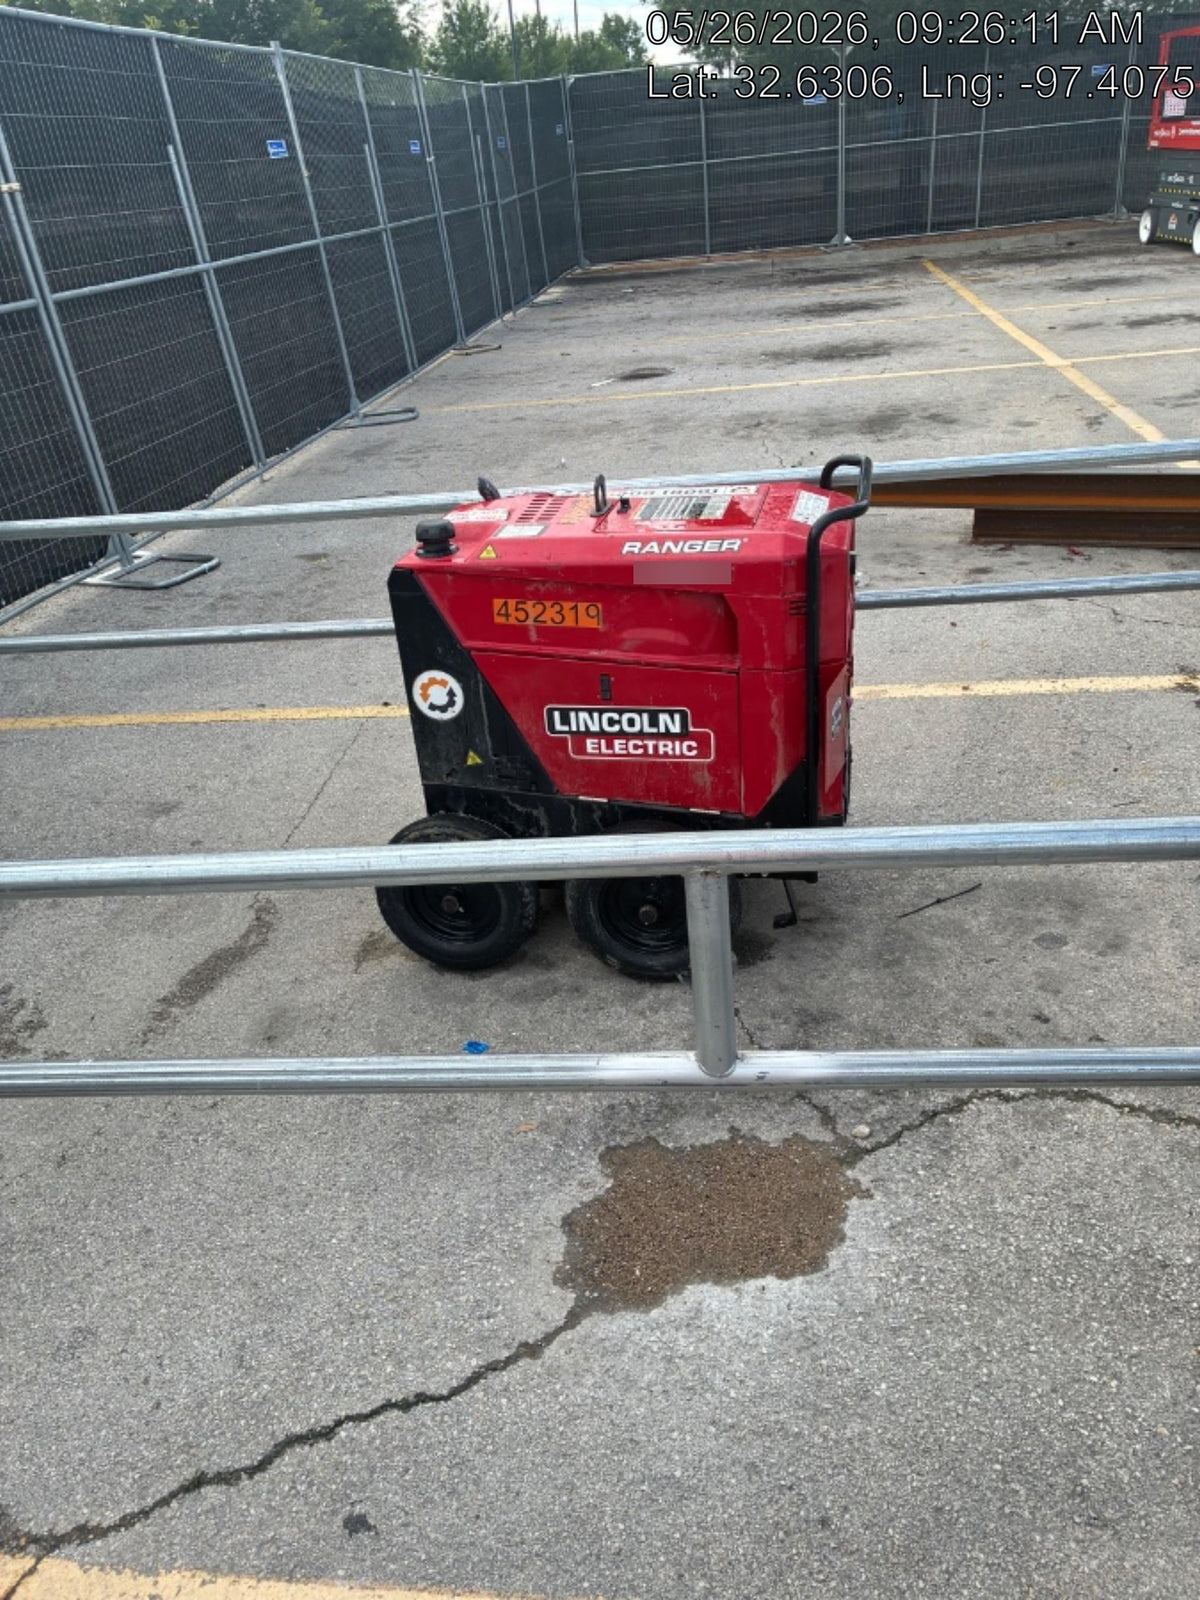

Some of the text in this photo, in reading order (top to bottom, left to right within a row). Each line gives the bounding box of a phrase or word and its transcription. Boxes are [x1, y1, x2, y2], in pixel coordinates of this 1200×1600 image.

[621, 538, 742, 556] RANGER
[496, 600, 601, 626] 452319
[553, 710, 683, 734] LINCOLN
[585, 738, 699, 757] ELECTRIC
